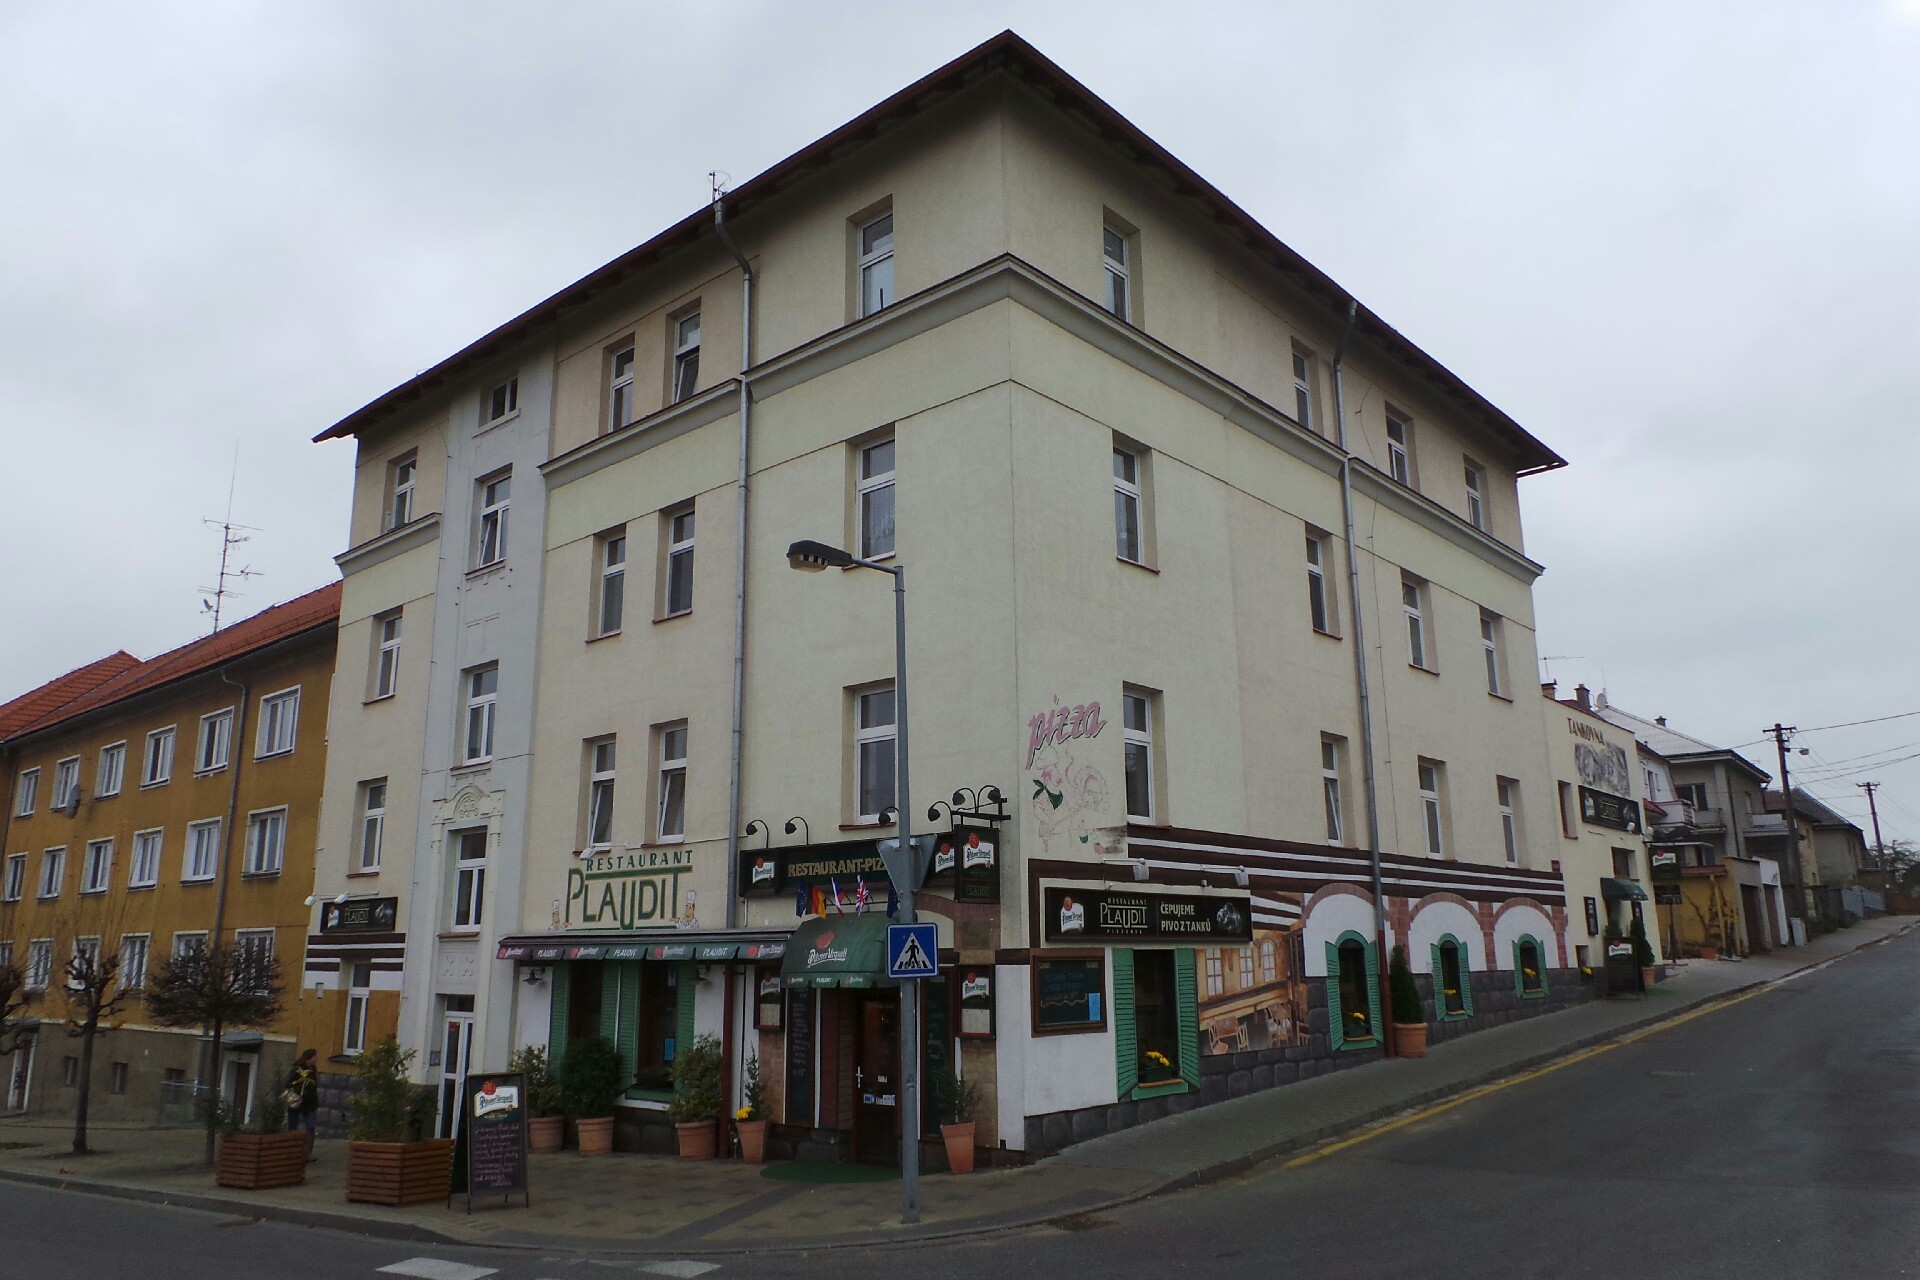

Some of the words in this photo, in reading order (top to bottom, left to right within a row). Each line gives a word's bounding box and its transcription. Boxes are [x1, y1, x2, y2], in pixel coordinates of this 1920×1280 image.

[1025, 694, 1108, 770] pizza
[586, 850, 693, 871] RESTAURANT
[788, 857, 887, 877] RESTAURANT-PIZ
[565, 866, 692, 930] PLAUDIT
[1107, 897, 1147, 905] RESTAURANT
[1100, 902, 1147, 928] PLAUDIT
[1160, 902, 1195, 917] ČEPUJEME
[1161, 920, 1179, 932] PIVO
[1179, 921, 1185, 931] Z
[1185, 918, 1211, 932] TANKŮ
